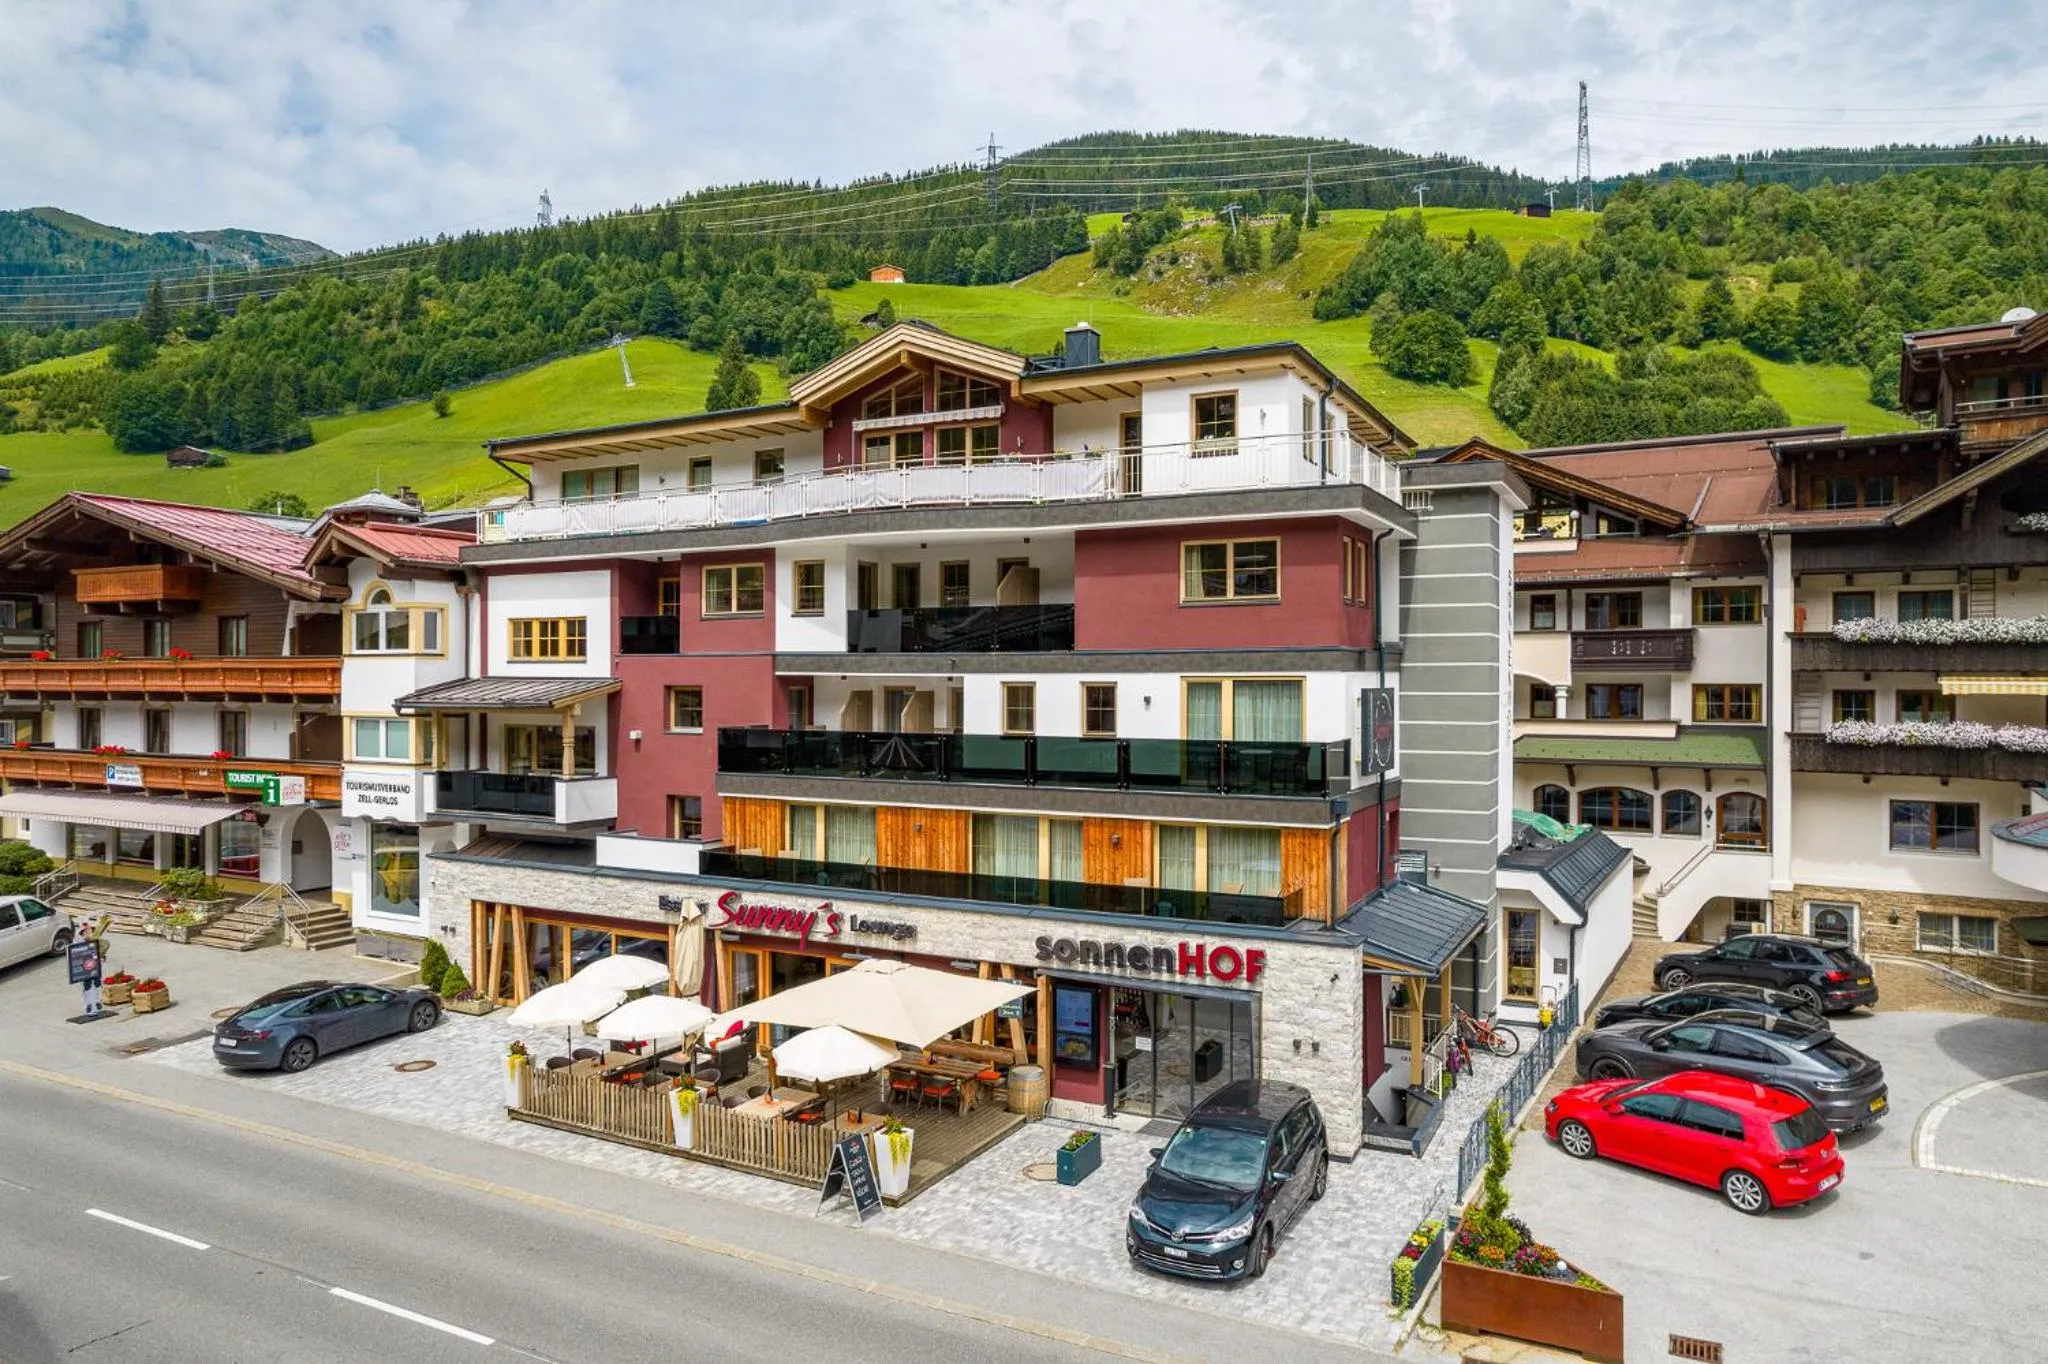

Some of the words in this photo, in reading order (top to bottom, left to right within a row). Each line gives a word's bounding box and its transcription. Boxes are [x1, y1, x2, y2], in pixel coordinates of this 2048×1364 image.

[228, 772, 255, 783] TOURIST
[346, 781, 411, 795] TOURISMUSVERBAND
[358, 794, 398, 806] ZELL-GERLOS
[850, 914, 918, 941] Lounge
[1035, 935, 1267, 983] sonnenHOF
